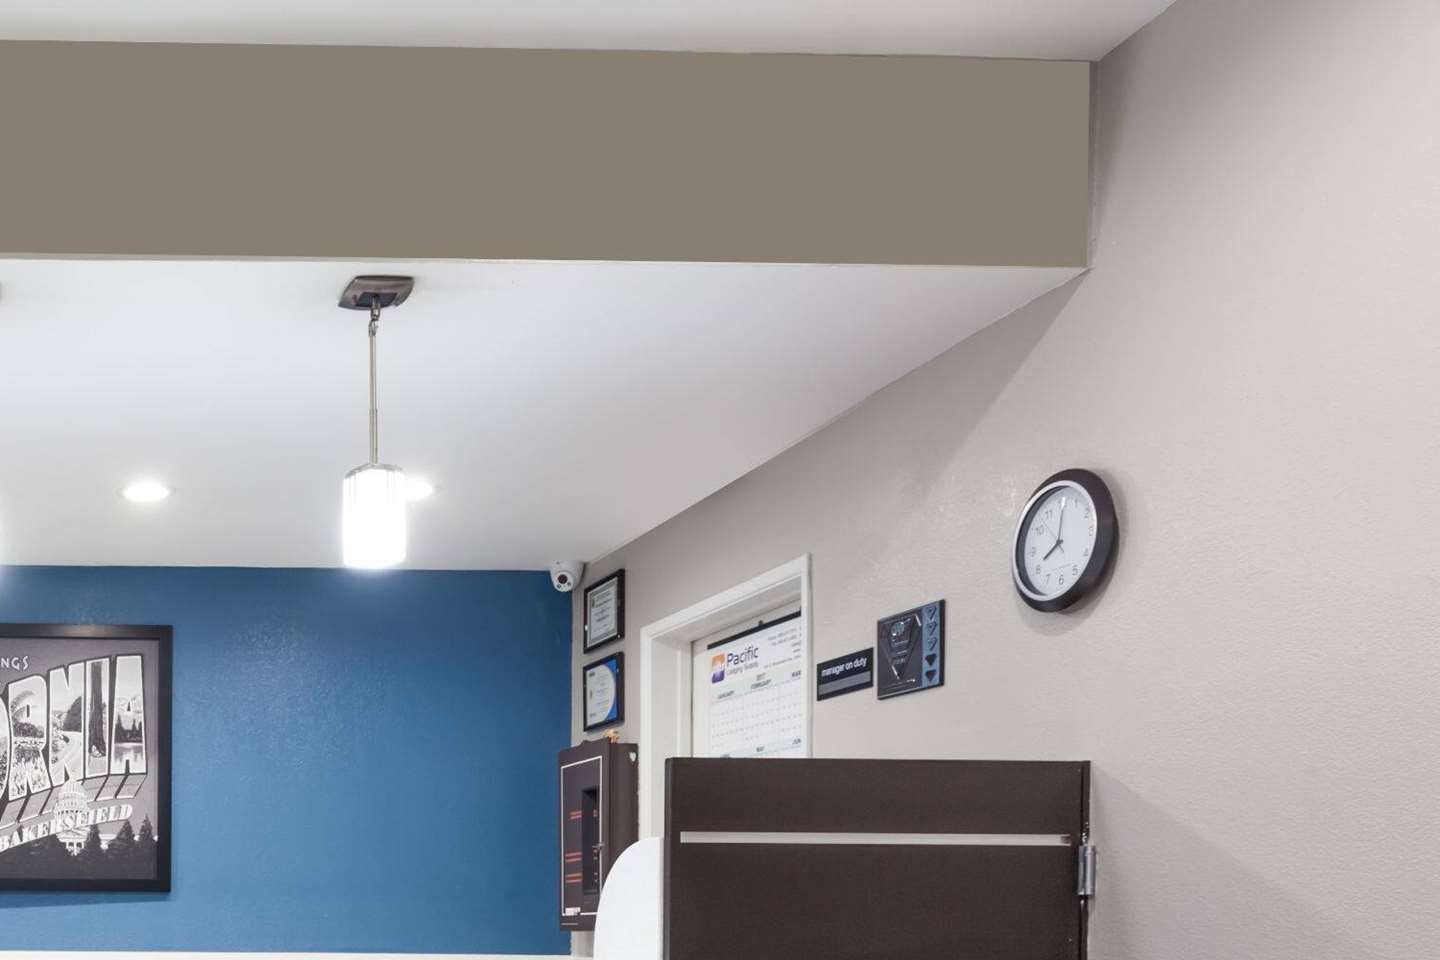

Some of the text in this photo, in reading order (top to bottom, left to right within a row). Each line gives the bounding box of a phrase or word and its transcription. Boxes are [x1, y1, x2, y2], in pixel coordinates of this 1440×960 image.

[1059, 575, 1065, 585] 6
[727, 645, 759, 667] Pacific
[821, 656, 867, 677] manager on duty
